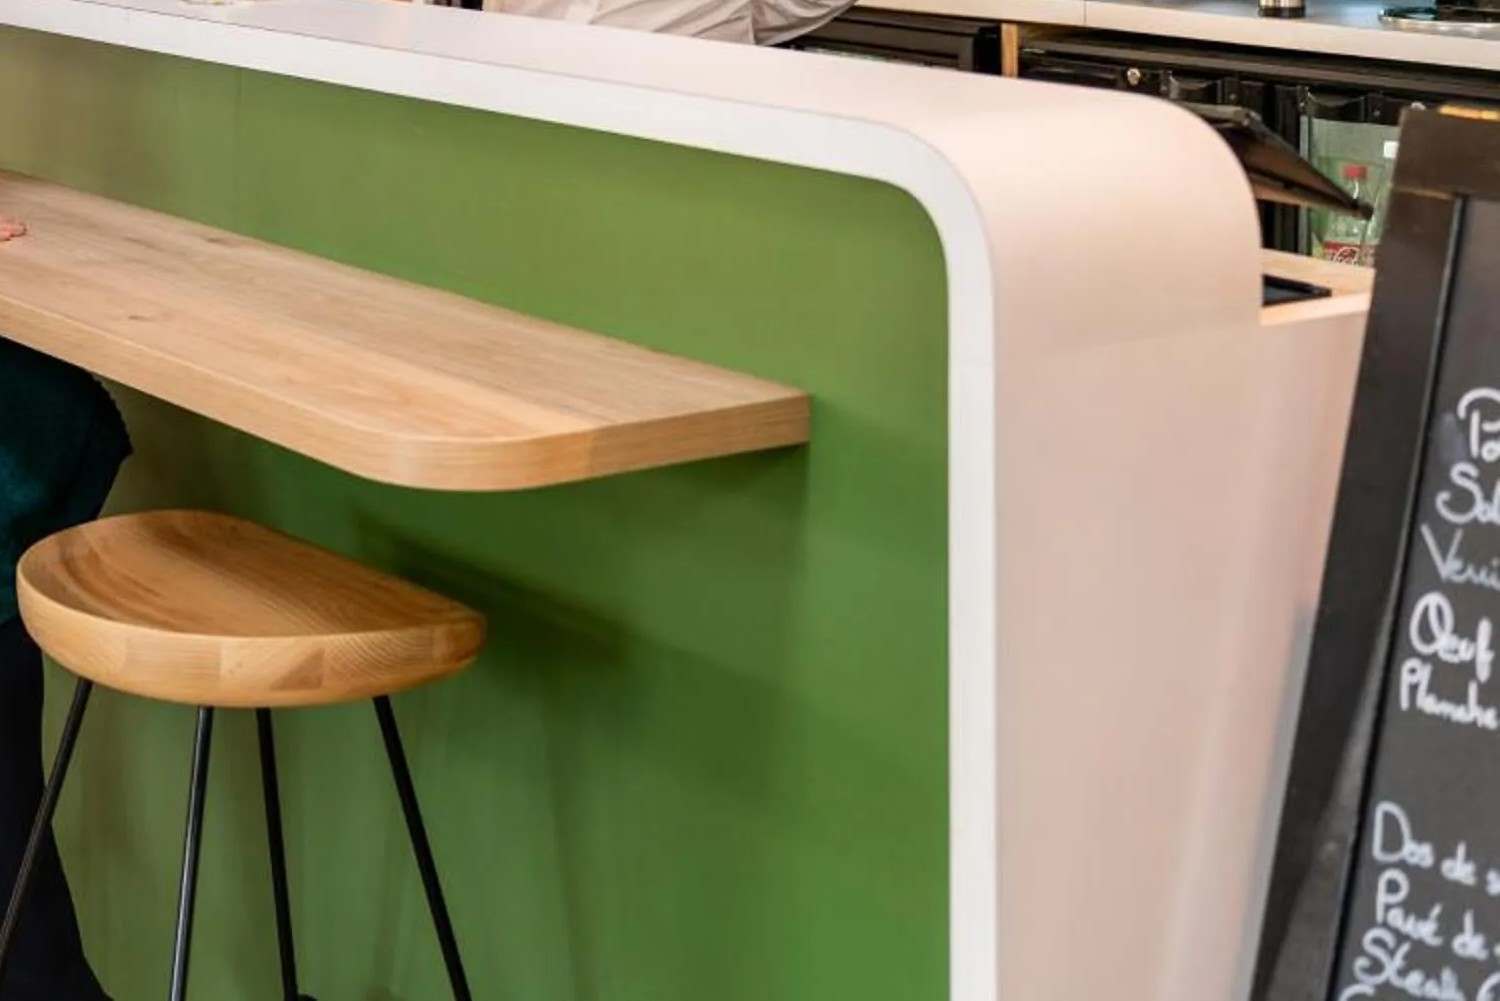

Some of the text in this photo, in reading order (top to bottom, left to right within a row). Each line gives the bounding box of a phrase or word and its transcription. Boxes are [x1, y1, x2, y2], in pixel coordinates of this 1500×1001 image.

[1372, 800, 1436, 869] Dos
[1440, 840, 1478, 887] de
[1451, 908, 1491, 961] de
